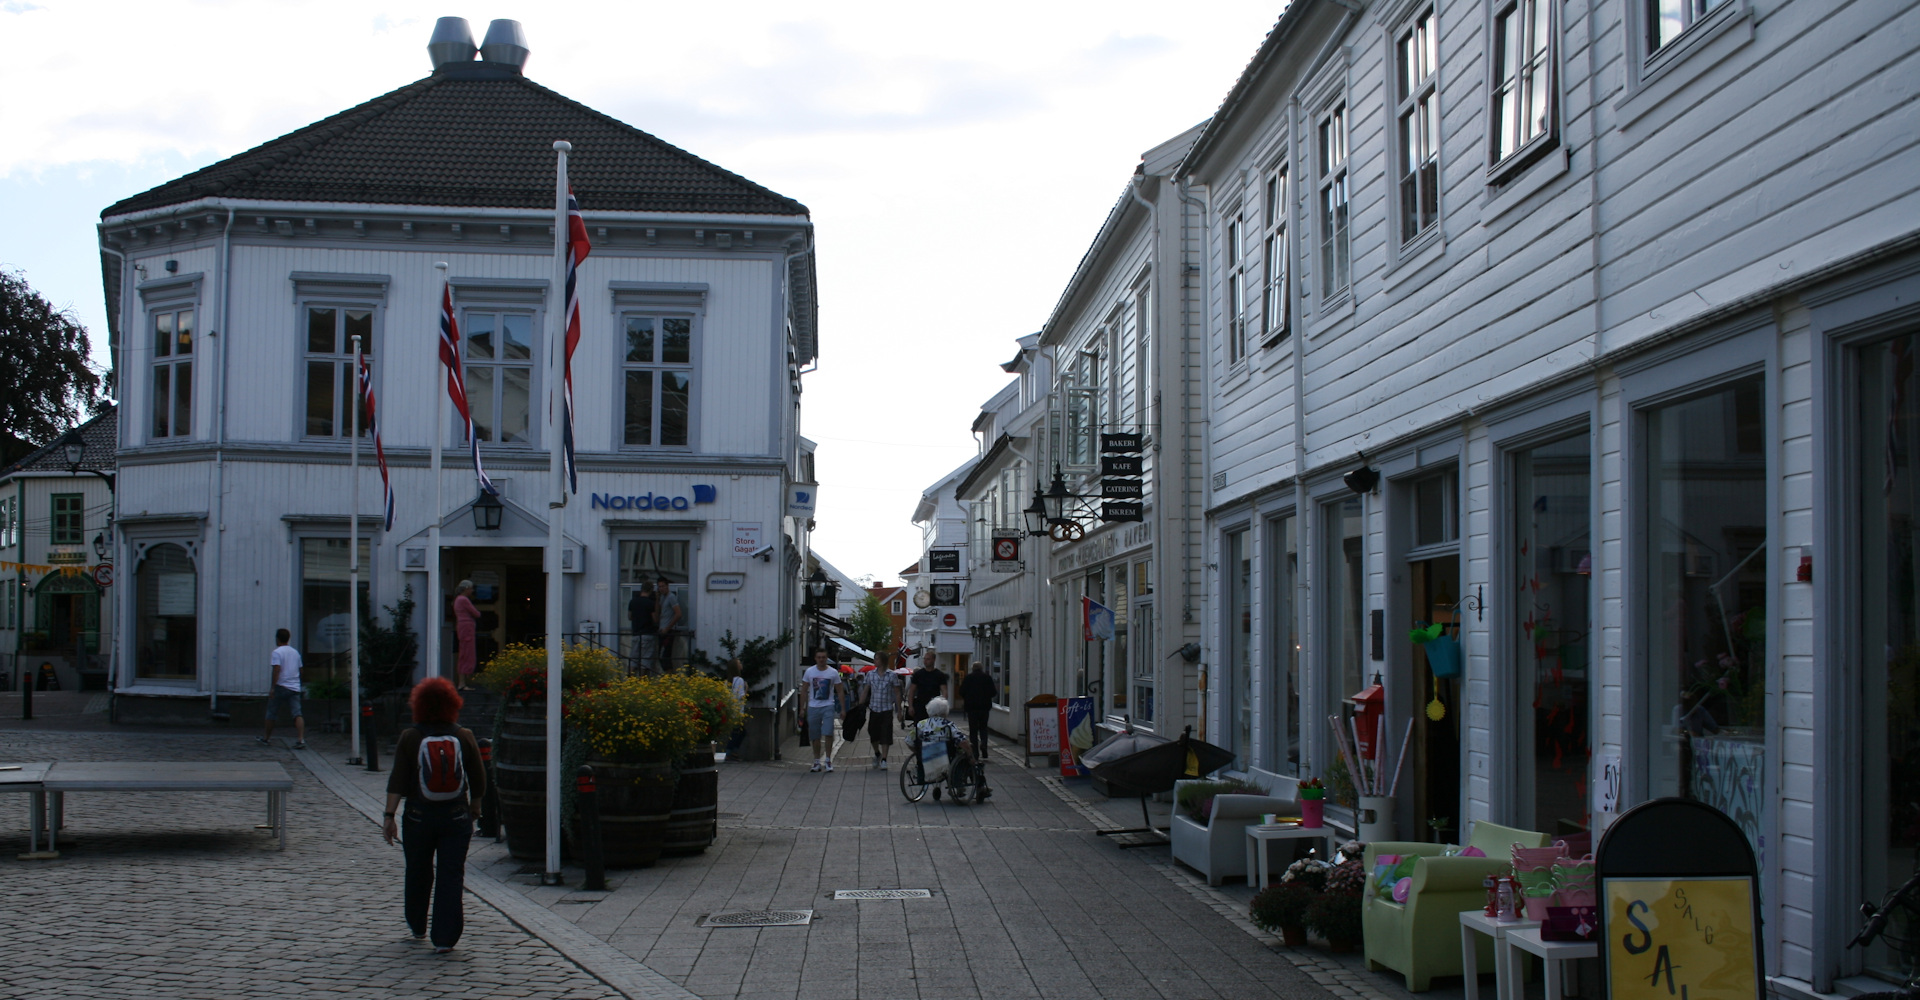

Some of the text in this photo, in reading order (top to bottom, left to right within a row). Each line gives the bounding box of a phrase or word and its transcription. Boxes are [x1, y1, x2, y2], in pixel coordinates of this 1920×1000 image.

[591, 492, 688, 511] Nordea
[1109, 508, 1136, 516] ISKREM
[735, 537, 755, 545] Store
[1060, 700, 1092, 719] Soft-is
[1623, 899, 1689, 1000] SA
